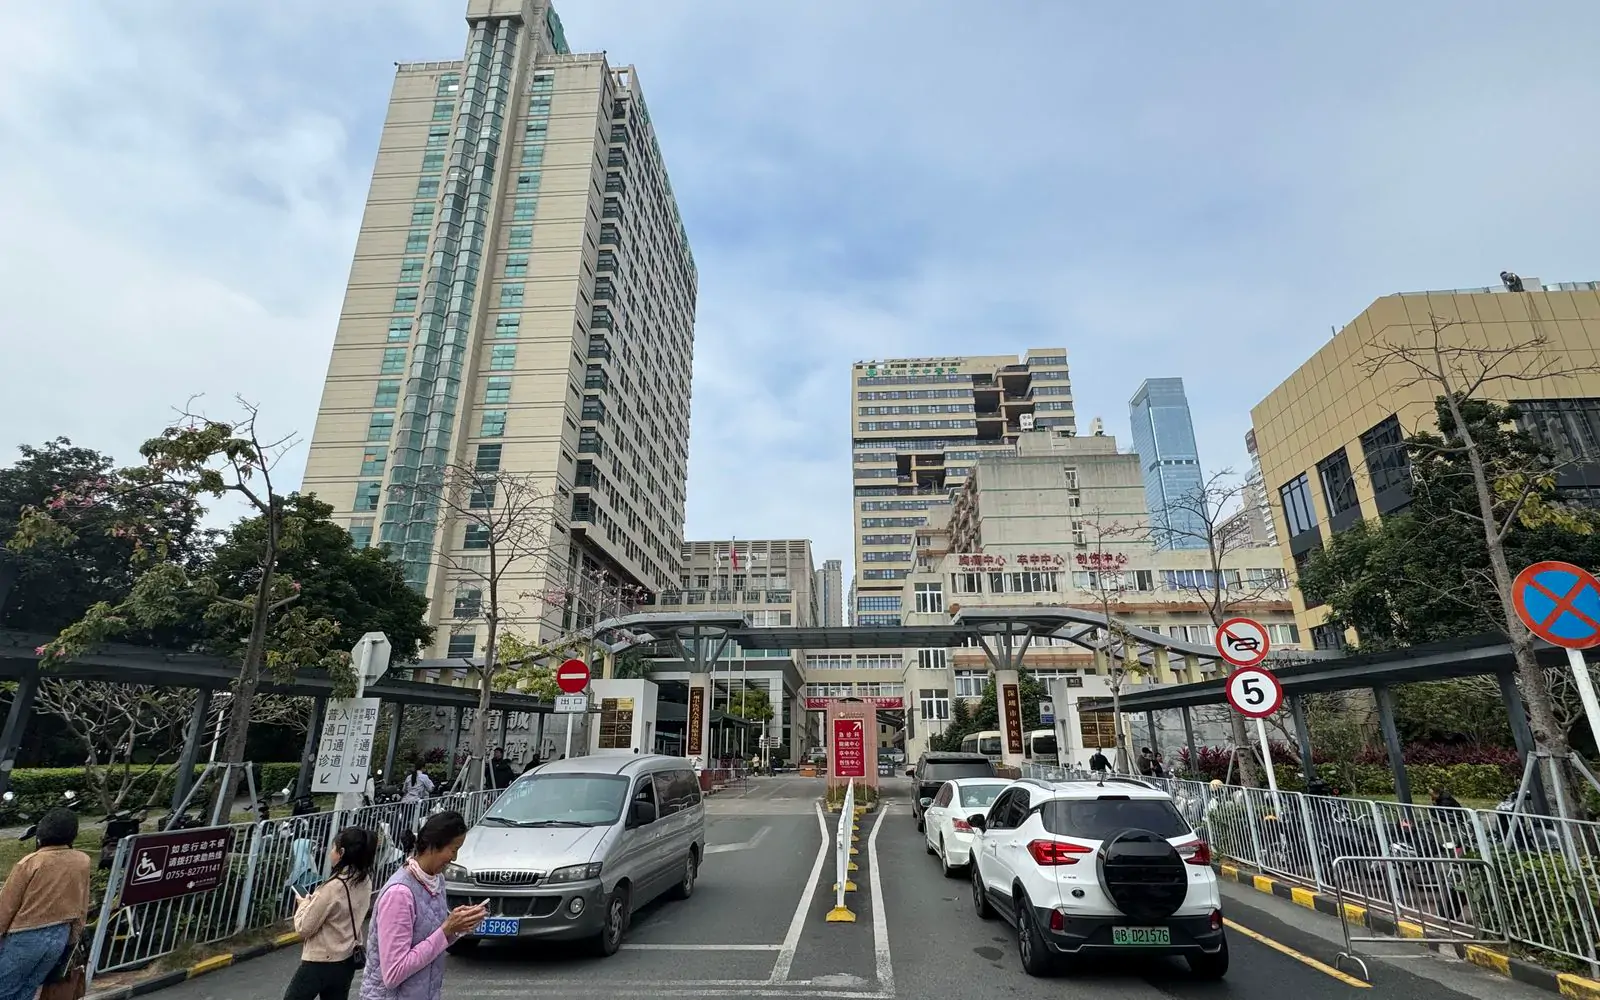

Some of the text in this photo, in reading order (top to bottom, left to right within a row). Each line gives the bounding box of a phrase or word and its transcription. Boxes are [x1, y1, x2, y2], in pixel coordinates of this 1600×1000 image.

[958, 554, 1007, 566] 胸痛中心
[1017, 554, 1065, 566] 卒中中心
[1075, 553, 1128, 565] 创伤中心
[1242, 678, 1265, 705] 5
[318, 708, 339, 768] 普通门诊
[330, 708, 350, 768] 入口通道
[355, 708, 377, 768] 职工通道
[171, 838, 225, 855] 如您行动不便
[168, 851, 223, 867] 请拨打求助热线
[165, 863, 220, 880] 0755-82771141
